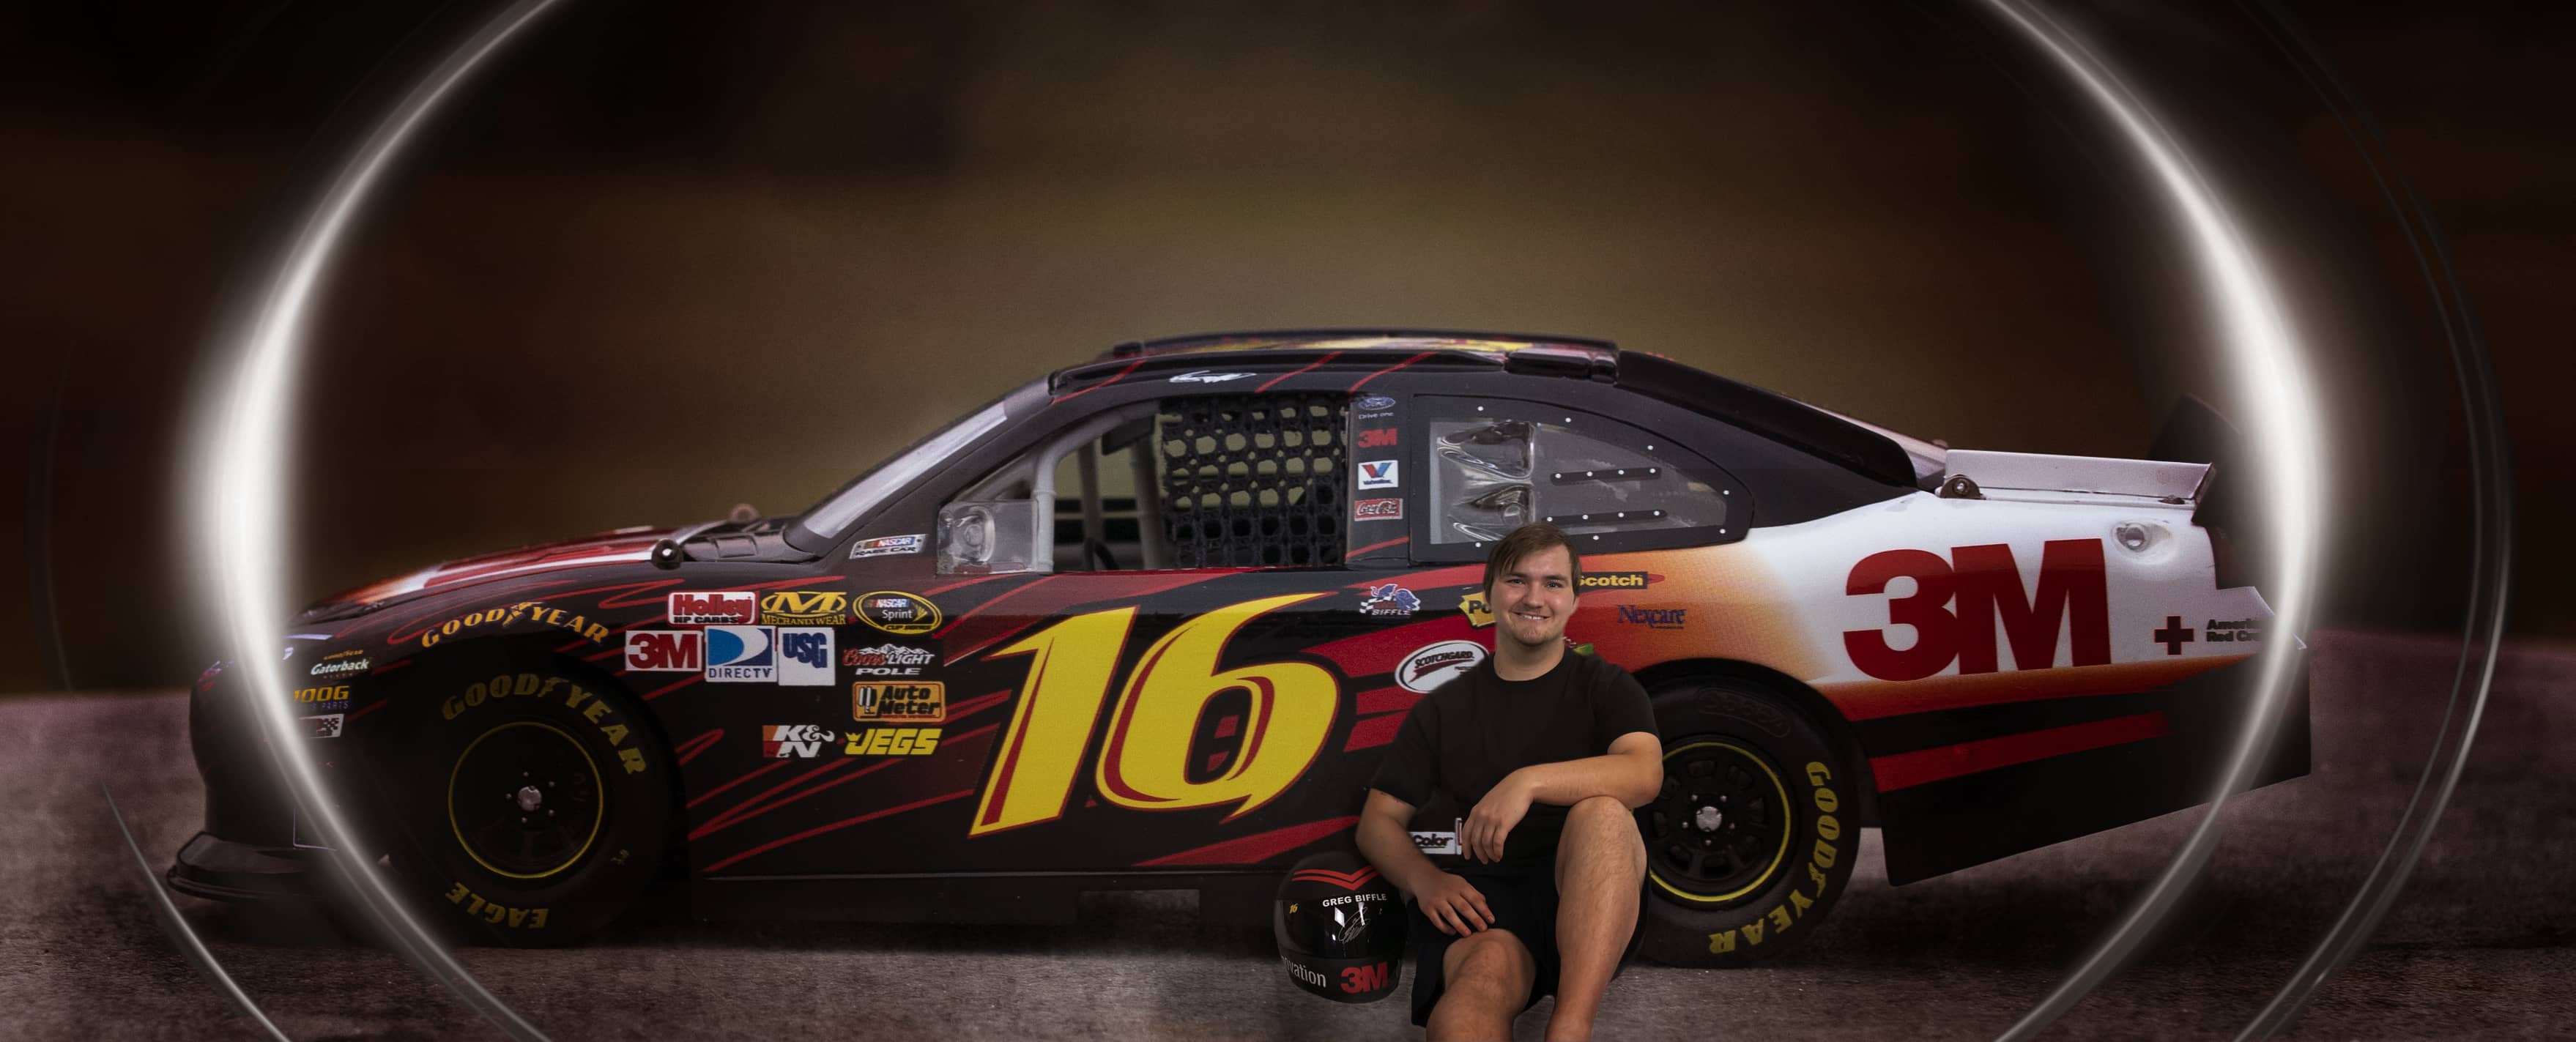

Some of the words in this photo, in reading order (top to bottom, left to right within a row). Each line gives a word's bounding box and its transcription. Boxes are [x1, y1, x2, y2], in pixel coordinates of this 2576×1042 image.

[1358, 428, 1398, 448] 3M
[878, 536, 913, 547] NASCAR
[855, 548, 888, 557] RACE
[673, 594, 753, 623] Holley
[875, 598, 909, 608] NASCAR
[1843, 538, 2112, 681] 3M
[762, 614, 814, 625] MECHANIX
[814, 614, 846, 625] WEAR
[881, 609, 913, 621] Sprint
[1617, 605, 1687, 629] Nexcare
[421, 602, 609, 647] GOODYEAR
[2206, 619, 2259, 630] Ameri
[2206, 630, 2234, 641] Red
[628, 633, 698, 669] 3M
[782, 632, 828, 669] USG
[843, 649, 886, 666] Coors
[887, 653, 935, 665] LIGHT
[311, 658, 370, 675] Gatorback
[1414, 651, 1476, 669] SCOTCHGARD
[708, 668, 773, 678] DIRECTV
[294, 685, 351, 703] OOG
[880, 685, 932, 700] Auto
[877, 700, 941, 715] Meter
[968, 592, 1339, 838] 16
[442, 674, 647, 775] GOODYEAR
[845, 728, 943, 755] JEGS
[1414, 833, 1454, 846] Color
[1708, 761, 1841, 954] GOODYEAR
[445, 881, 550, 930] EAGLE
[1322, 896, 1352, 907] GREG
[1354, 893, 1388, 903] BIFFLE
[1289, 904, 1299, 914] 16
[1340, 961, 1389, 994] 3M
